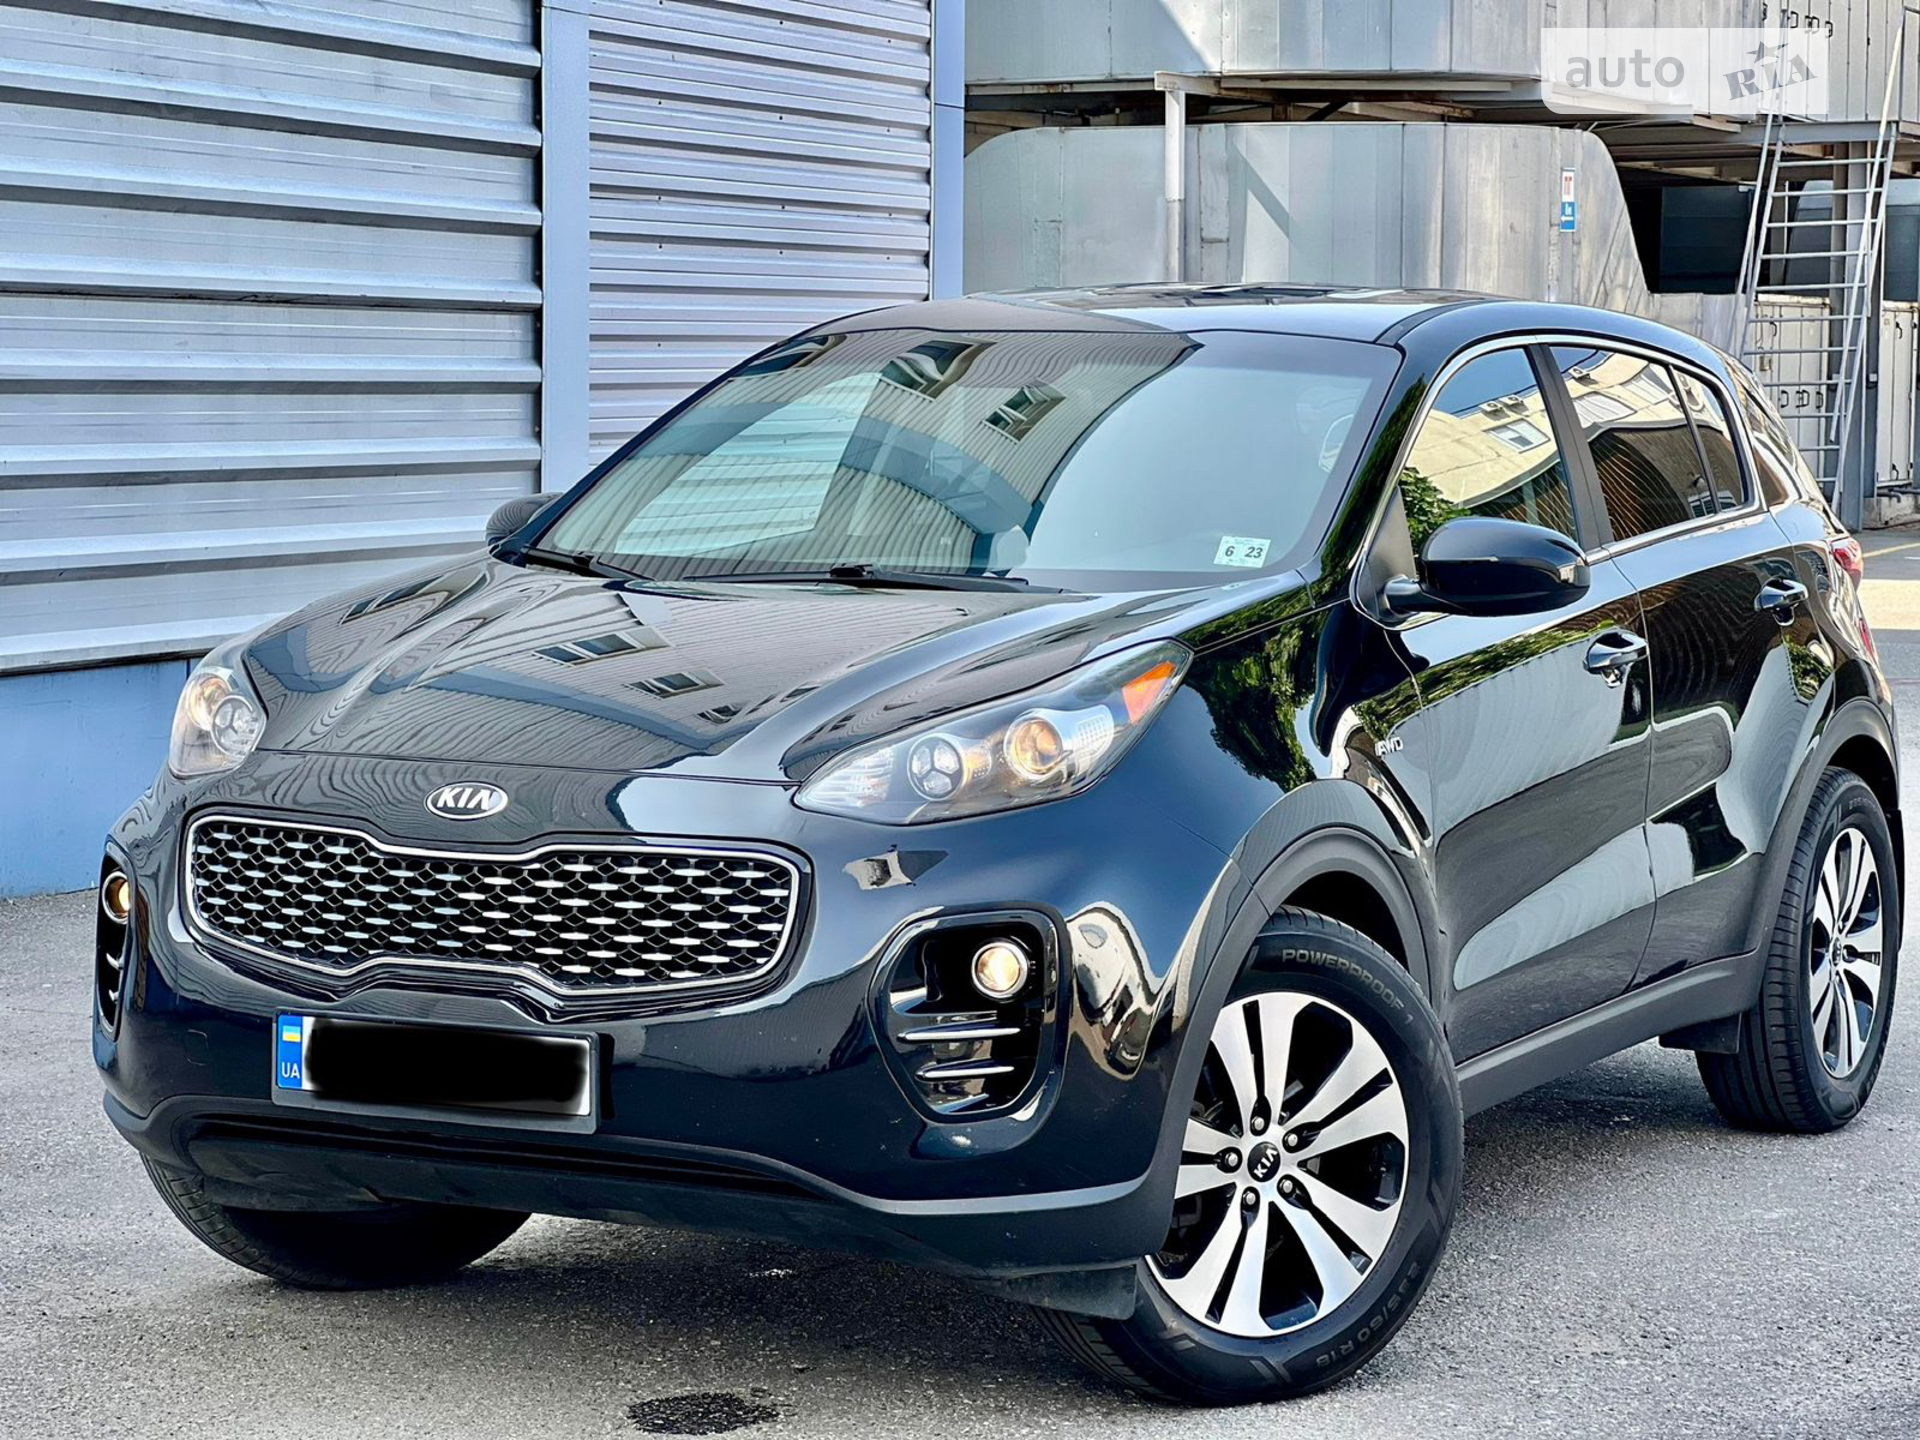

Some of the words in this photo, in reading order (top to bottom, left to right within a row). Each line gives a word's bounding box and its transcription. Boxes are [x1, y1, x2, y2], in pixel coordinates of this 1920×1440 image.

[1224, 545, 1235, 557] 6
[1244, 546, 1263, 559] 23
[1374, 737, 1404, 757] AWD
[436, 787, 490, 811] KIA
[1282, 949, 1405, 1010] POWERPROOF
[281, 1061, 300, 1079] UA
[1253, 1148, 1279, 1179] KIA
